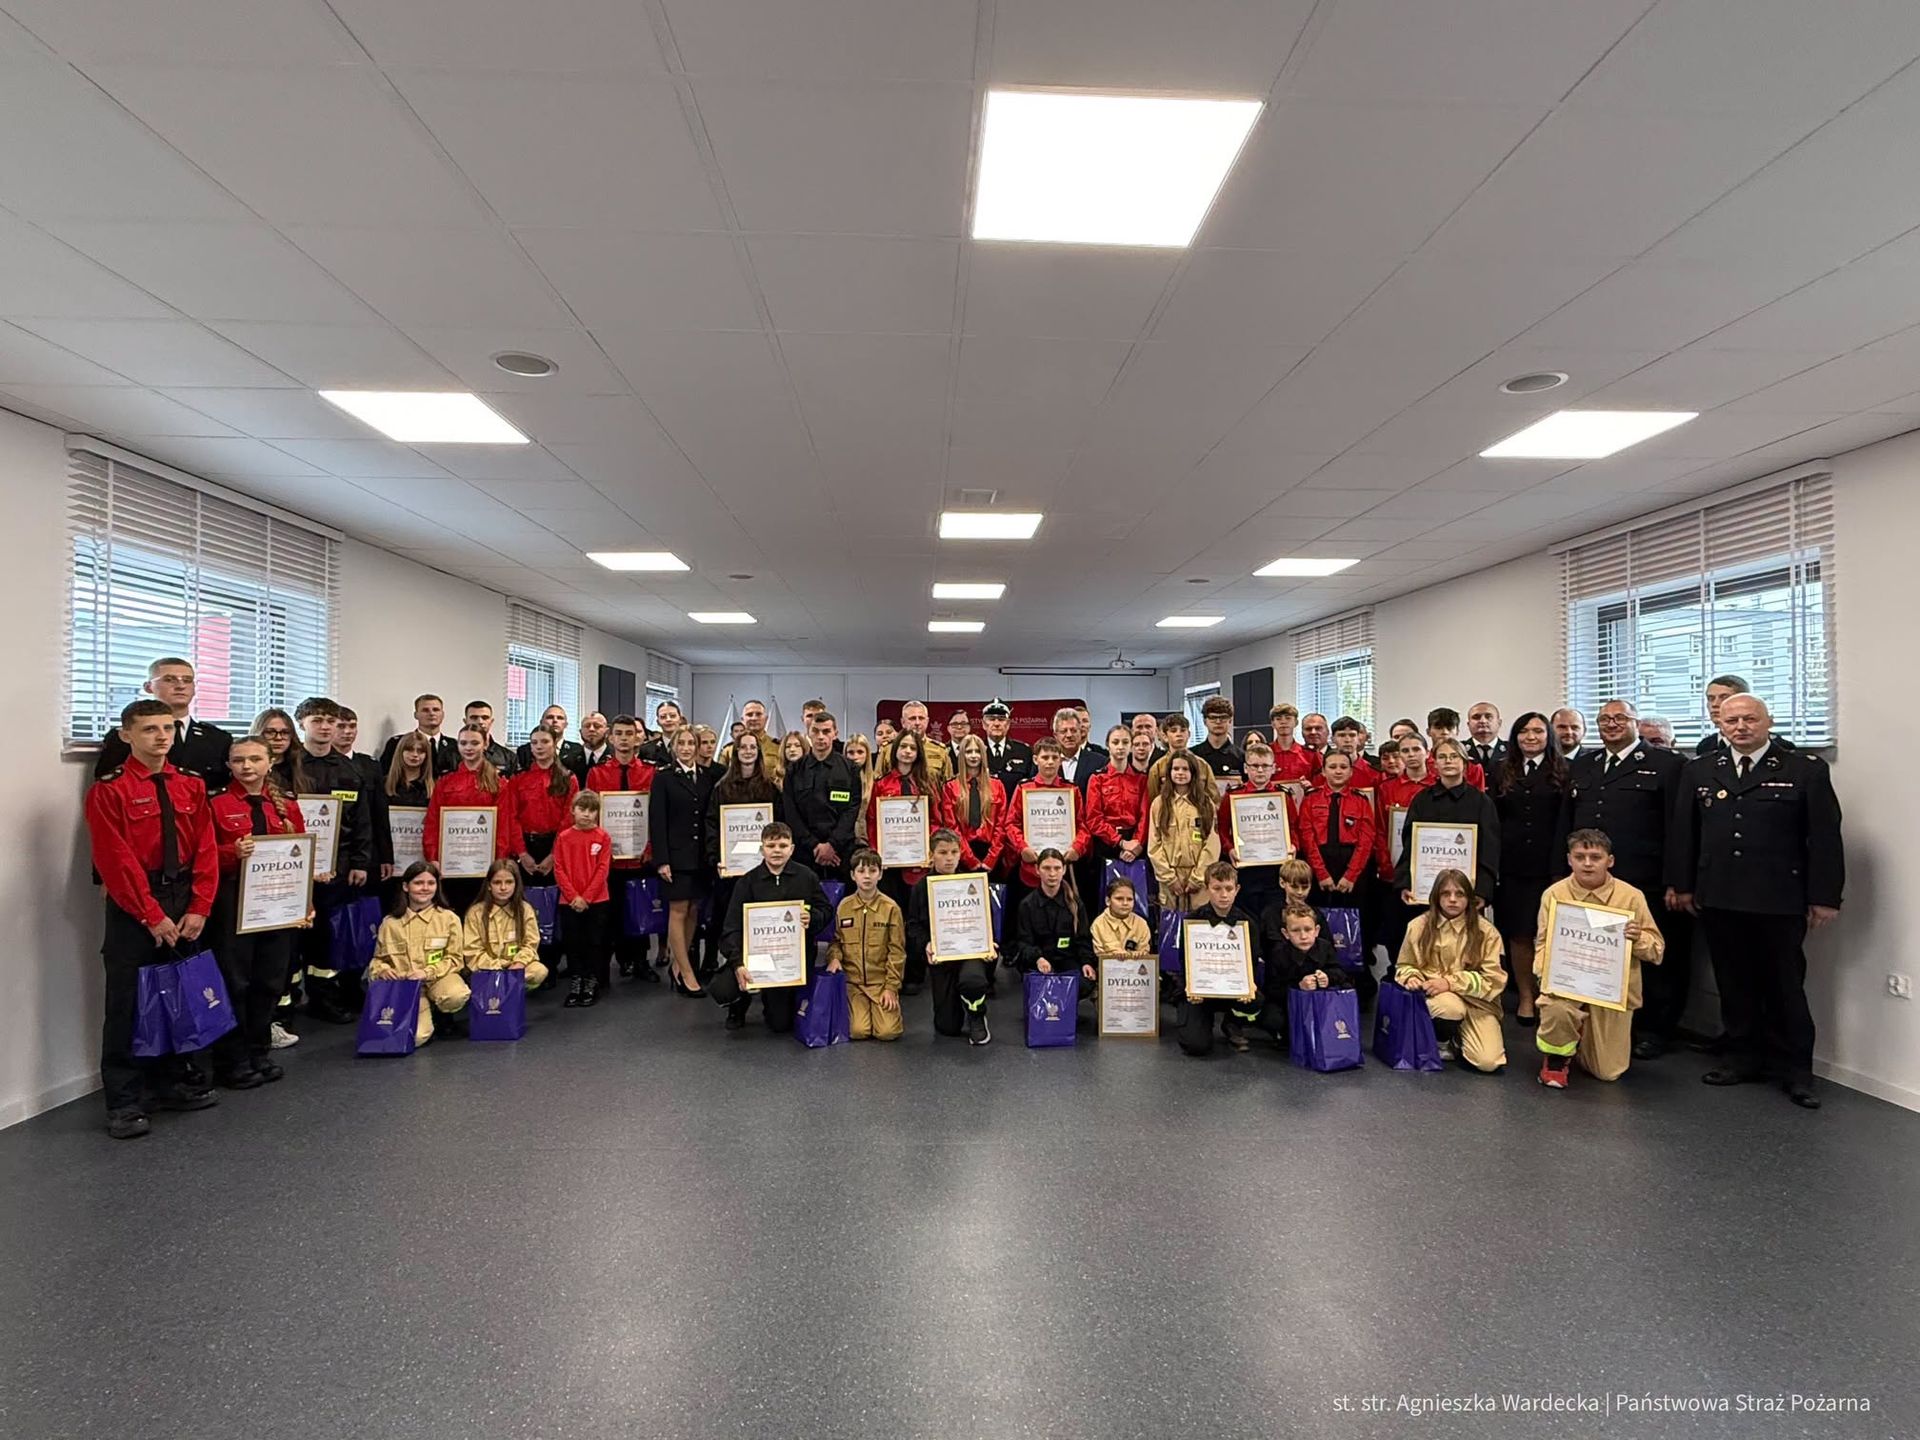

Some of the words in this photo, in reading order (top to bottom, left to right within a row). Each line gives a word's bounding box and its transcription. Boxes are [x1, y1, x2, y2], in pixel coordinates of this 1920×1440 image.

[1030, 808, 1067, 816] DYPLOM
[884, 816, 921, 824] DYPLOM
[1240, 813, 1279, 823] DYPLOM
[391, 826, 424, 835] DYPLO
[448, 827, 488, 835] DYPLOM
[1421, 846, 1467, 856] DYPLOM
[252, 861, 303, 873] DYPLOM
[938, 898, 980, 908] DYPLOM
[753, 925, 796, 935] DYPLOM
[1560, 927, 1619, 947] DYPLOM
[1194, 942, 1241, 951] DYPLOM
[1107, 978, 1150, 987] DYPLOM
